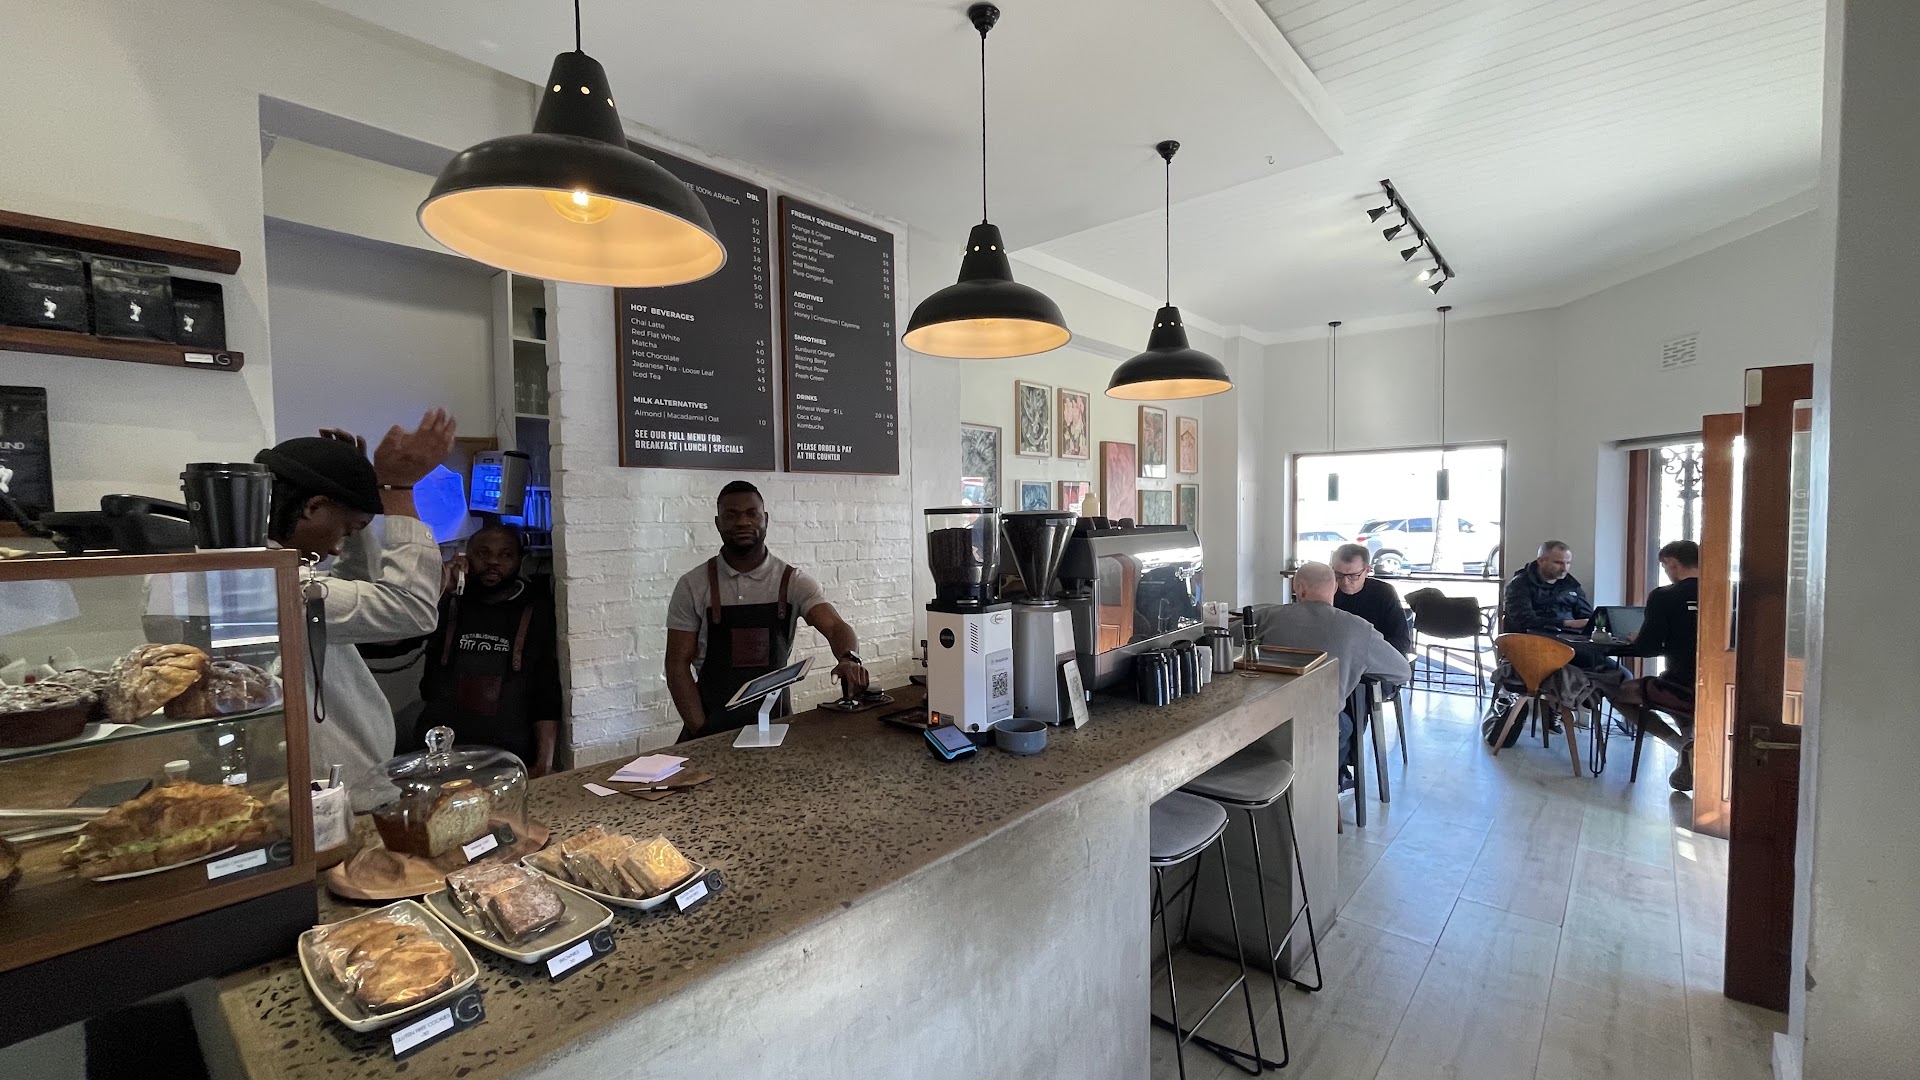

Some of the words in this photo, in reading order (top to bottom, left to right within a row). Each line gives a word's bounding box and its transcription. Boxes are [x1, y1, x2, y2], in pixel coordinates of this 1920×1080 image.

[695, 185, 712, 197] 100%
[713, 191, 741, 205] ARABICA
[746, 192, 760, 202] DBL
[751, 218, 760, 226] 30
[791, 209, 816, 223] FRESHLY
[816, 217, 845, 232] SQUEEZED
[844, 226, 860, 237] FRUIT
[860, 232, 877, 243] JUICES
[752, 227, 760, 235] 32
[791, 223, 810, 235] Orange
[815, 230, 832, 241] Ginger
[791, 233, 807, 242] Apple
[812, 238, 824, 247] Mint
[753, 246, 761, 254] 35
[792, 242, 808, 251] Carrot
[808, 246, 818, 254] and
[818, 249, 835, 259] Ginger
[792, 251, 808, 261] Green
[808, 254, 818, 263] Mix
[792, 260, 803, 268] Red
[803, 262, 825, 274] Beetroot
[753, 274, 762, 282] 50
[792, 269, 805, 278] Pure
[805, 272, 822, 282] Ginger
[822, 276, 834, 285] Shot
[793, 290, 824, 303] ADDITIVES
[754, 302, 764, 310] 50
[793, 301, 806, 309] CBD
[630, 303, 647, 313] HOT
[650, 307, 695, 322] BEVERAGES
[630, 317, 647, 327] Chai
[648, 320, 665, 330] Latte
[793, 310, 811, 320] Honey
[813, 314, 838, 325] Cinnamon
[840, 320, 861, 330] Cayenne
[631, 328, 646, 337] Red
[647, 330, 659, 339] Flat
[660, 333, 681, 343] White
[793, 333, 827, 346] SMOOTHIES
[631, 339, 658, 349] Matcha
[631, 350, 645, 358] Hot
[646, 351, 680, 362] Chocolate
[794, 345, 817, 355] Sunburst
[817, 349, 836, 358] Orange
[215, 353, 231, 365] G
[794, 354, 814, 364] Blazing
[813, 357, 827, 366] Berry
[632, 360, 664, 371] Japanese
[665, 364, 677, 372] Tea
[682, 366, 700, 376] Loose
[701, 369, 714, 377] Leaf
[757, 376, 766, 384] 45
[794, 363, 813, 372] Peanut
[813, 366, 829, 374] Power
[632, 371, 648, 379] Iced
[648, 372, 662, 381] Tea
[795, 372, 810, 380] Fresh
[809, 374, 825, 382] Green
[633, 396, 653, 405] MILK
[653, 398, 708, 410] ALTERNATIVES
[796, 393, 818, 402] DRINKS
[796, 404, 815, 412] Mineral
[815, 406, 830, 414] Water
[634, 409, 662, 418] Almond
[666, 412, 704, 422] Macadamia
[707, 415, 720, 423] Oat
[796, 413, 809, 421] Coca
[796, 422, 825, 431] Kombucha
[634, 429, 648, 439] SEE
[650, 430, 667, 440] OUR
[668, 431, 685, 441] FULL
[686, 432, 706, 442] MENU
[707, 433, 721, 443] FOR
[635, 440, 678, 451] BREAKFAST
[683, 442, 707, 452] LUNCH
[713, 445, 744, 454] SPECIALS
[796, 442, 817, 452] PLEASE
[817, 443, 836, 452] ORDER
[836, 444, 841, 452] &
[841, 445, 853, 453] PAY
[796, 451, 804, 460] AT
[805, 452, 816, 460] THE
[816, 452, 841, 461] COUNTER
[462, 633, 499, 641] ESTABLISHED
[593, 929, 613, 952] G
[455, 994, 482, 1023] G
[395, 1030, 415, 1044] GLUTEN
[415, 1024, 427, 1033] FREE
[427, 1013, 450, 1027] COOKIES
